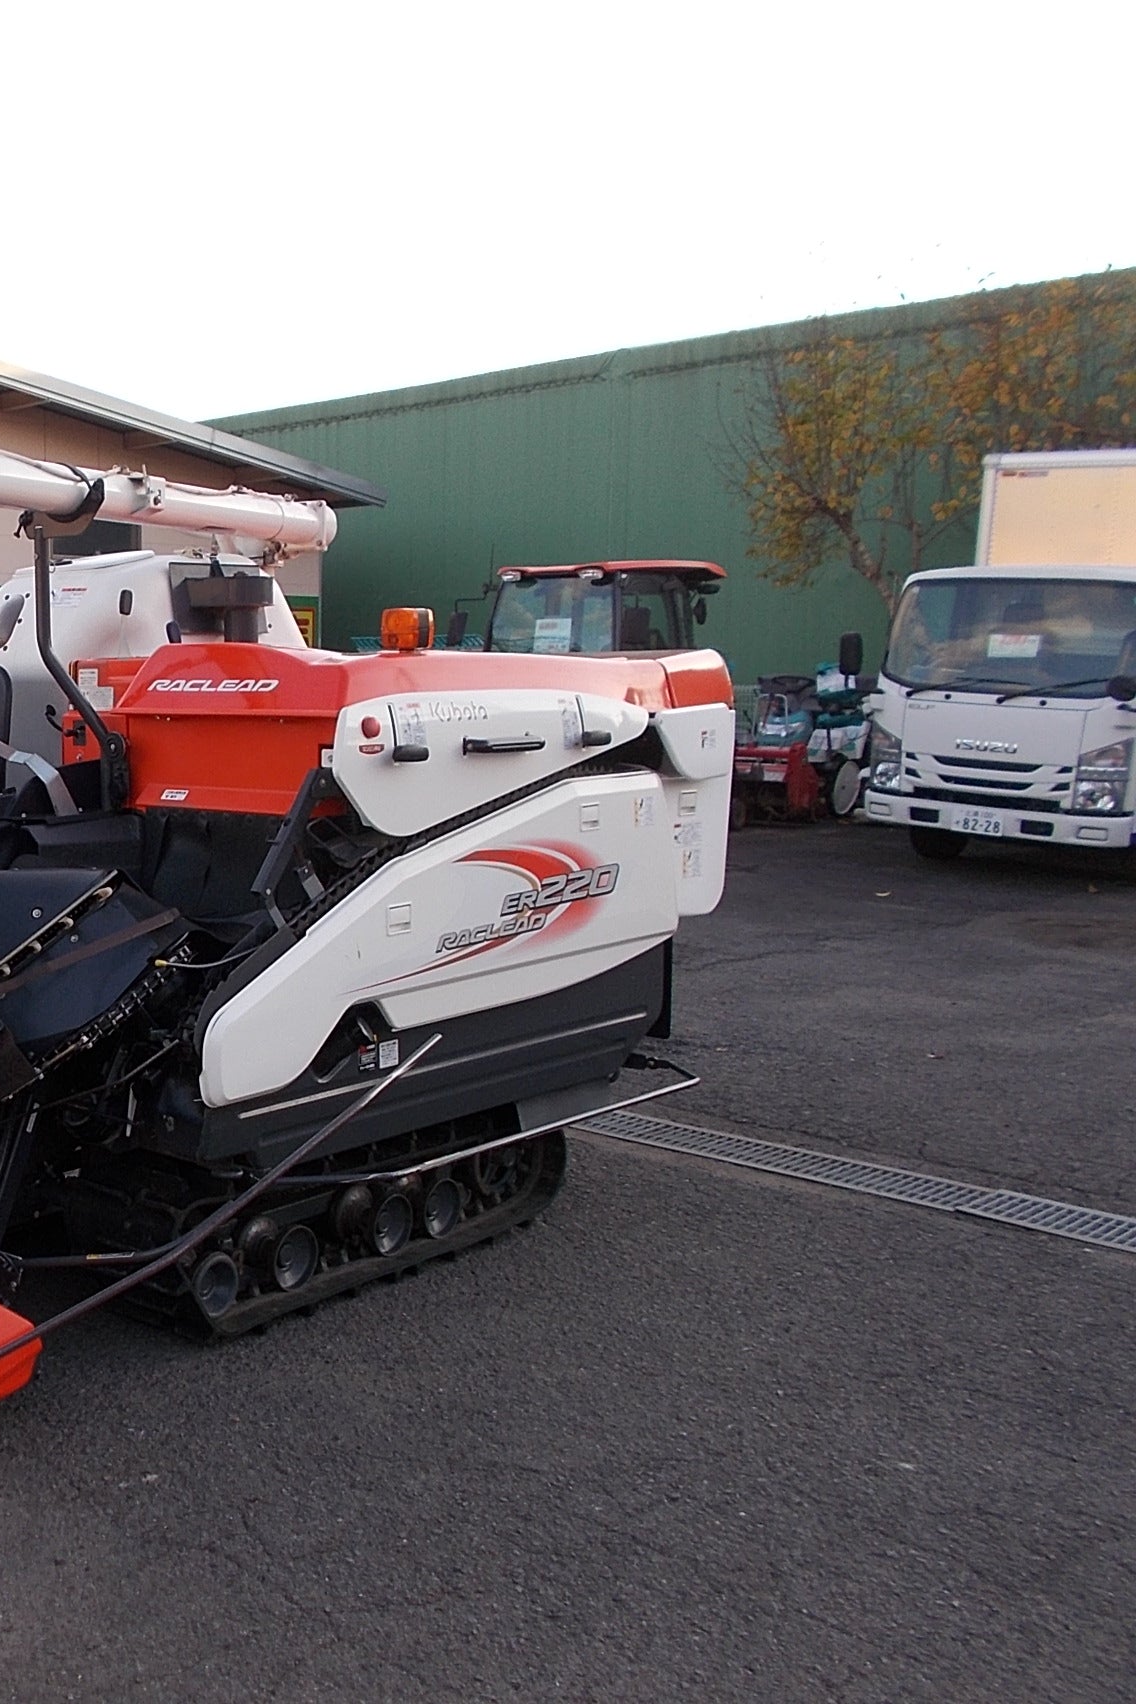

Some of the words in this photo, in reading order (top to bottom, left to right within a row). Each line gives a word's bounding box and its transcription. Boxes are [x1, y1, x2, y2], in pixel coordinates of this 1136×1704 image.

[146, 679, 280, 692] RACLEAD
[429, 701, 488, 722] Kubota
[955, 738, 1018, 754] ISUZU
[963, 817, 1000, 834] 82-28
[500, 863, 620, 917] ER220
[436, 912, 548, 953] RACLEAD
